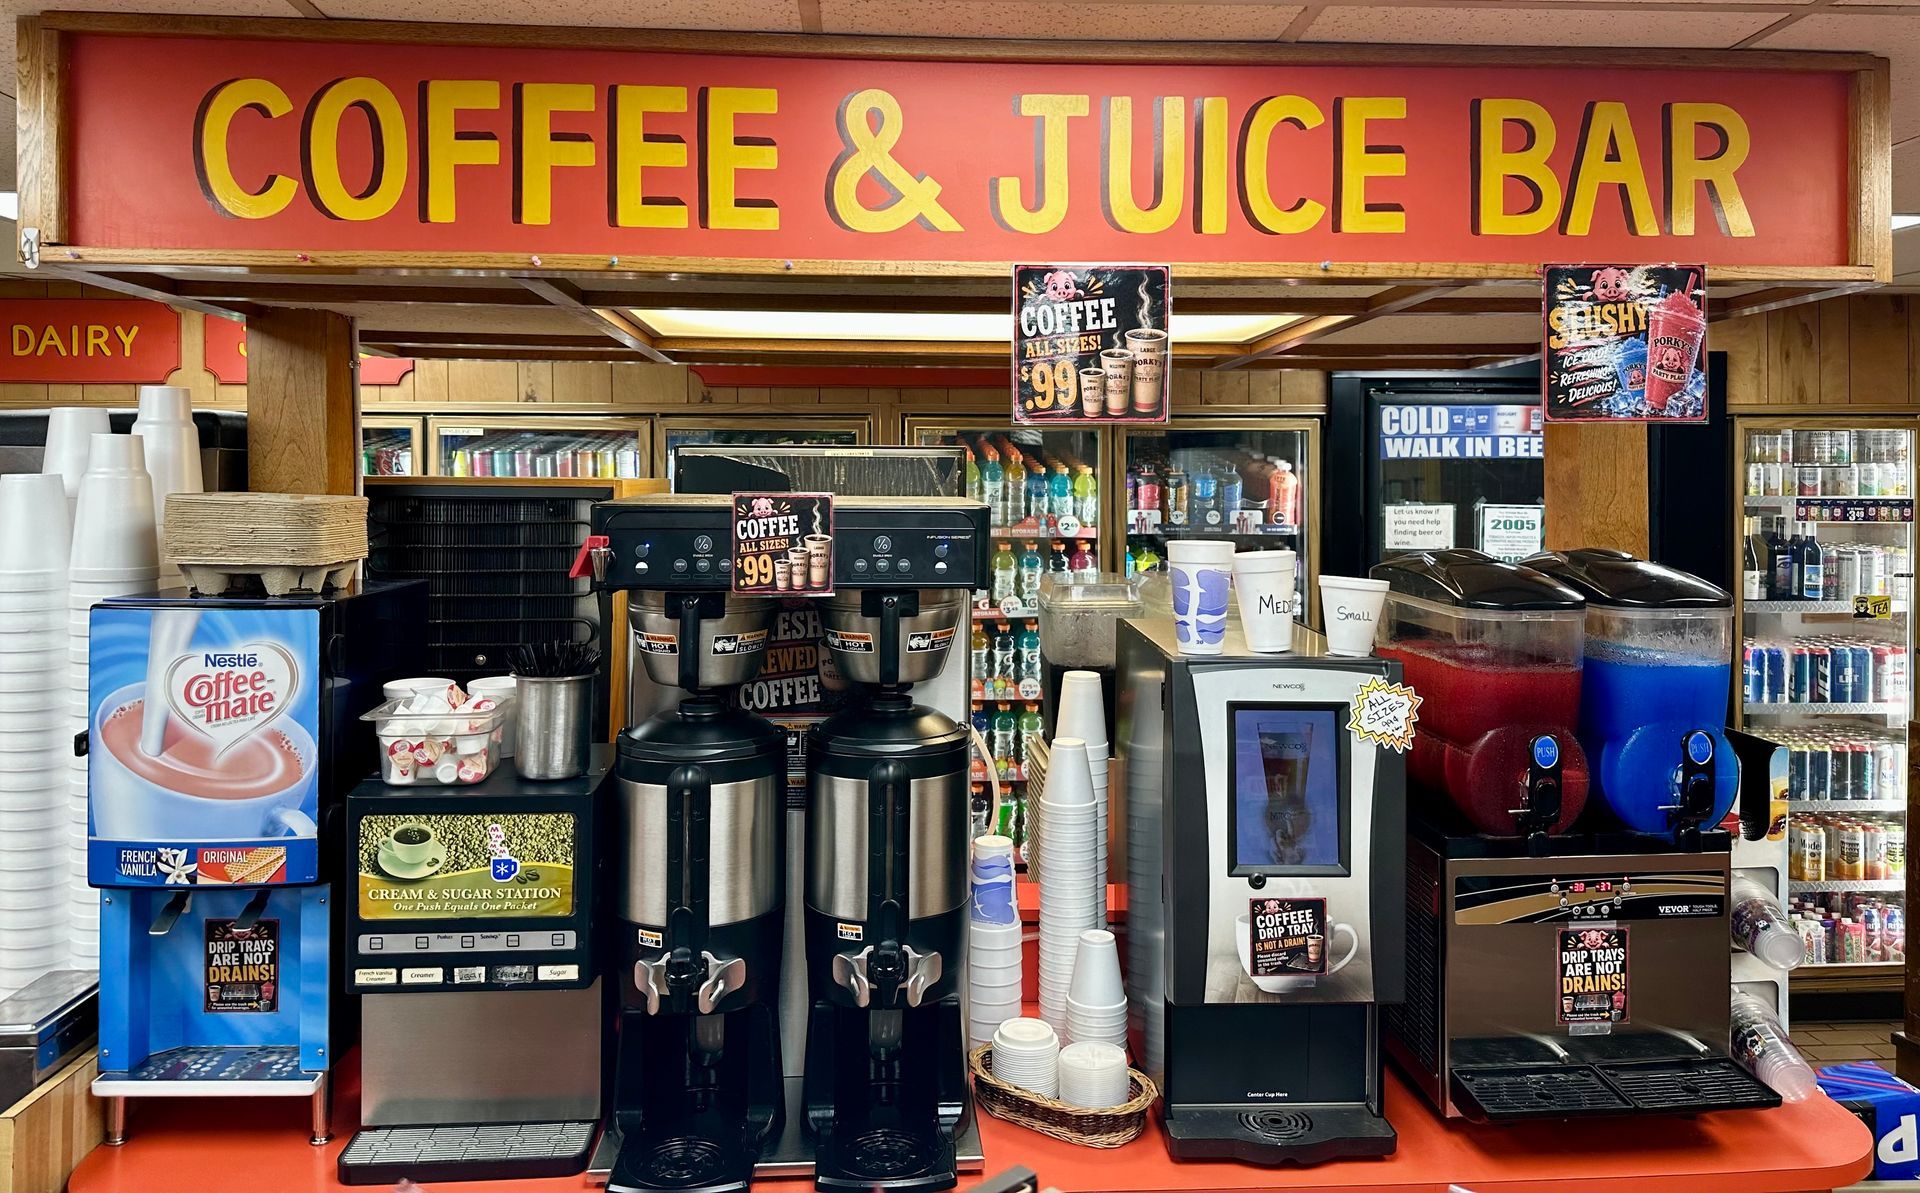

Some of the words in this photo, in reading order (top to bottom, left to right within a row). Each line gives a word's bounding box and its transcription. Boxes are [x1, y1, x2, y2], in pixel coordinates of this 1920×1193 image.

[197, 76, 781, 231] COFFEE
[828, 88, 963, 233] &
[990, 94, 1407, 236] JUICE
[1471, 97, 1756, 238] BAR
[1020, 297, 1117, 337] COFFEE
[1549, 302, 1649, 349] SLUSHY
[12, 324, 139, 357] DAIRY
[1026, 341, 1053, 358] ALL
[1057, 335, 1102, 354] SIZES!
[1653, 336, 1694, 356] PORKY'S
[1652, 368, 1668, 379] PARTY
[1669, 371, 1687, 381] PLACE
[1568, 379, 1618, 402] DELICIOUS!
[1382, 406, 1449, 435] COLD
[1385, 437, 1460, 458] WALK
[1465, 437, 1492, 457] IN
[1499, 437, 1544, 457] BEE
[736, 515, 799, 540] COFFEE
[1490, 519, 1536, 530] 2005
[740, 542, 758, 553] ALL
[760, 538, 790, 551] SIZES!
[736, 553, 774, 587] $.99
[1337, 606, 1373, 621] Small
[1872, 603, 1889, 614] TEA
[770, 610, 824, 640] ESH
[761, 645, 817, 674] EWED
[183, 670, 275, 707] Coffee-
[739, 675, 821, 711] COFFEE
[205, 692, 274, 724] mate
[1368, 695, 1391, 711] ALL
[1367, 700, 1405, 725] SIZES
[1537, 746, 1556, 758] PUSH
[1690, 742, 1710, 753] PUSH
[121, 850, 156, 863] FRENCH
[203, 851, 247, 863] ORIGINAL
[120, 863, 157, 876] VANILLA
[368, 889, 424, 900] CREAM
[426, 889, 438, 900] &
[442, 888, 493, 900] SUGAR
[494, 887, 562, 899] STATION
[393, 902, 413, 911] One
[415, 902, 441, 911] Push
[443, 902, 478, 913] Equals
[481, 902, 501, 911] One
[503, 901, 537, 911] Packet
[1658, 905, 1689, 913] VEVOR
[1256, 909, 1314, 929] COFFEEE
[1258, 926, 1285, 940] DRIP
[1286, 922, 1314, 936] TRAY
[209, 941, 235, 954] DRIP
[238, 939, 274, 952] TRAYS
[1255, 943, 1263, 952] IS
[1264, 941, 1277, 951] NOT
[1278, 940, 1283, 949] A
[1284, 937, 1306, 948] DRAIN!
[212, 953, 240, 966] ARE
[243, 951, 271, 965] NOT
[1562, 950, 1588, 964] DRIP
[1590, 948, 1625, 962] TRAYS
[209, 964, 275, 983] DRAINS!
[1565, 963, 1592, 977] ARE
[1595, 961, 1622, 975] NOT
[1562, 973, 1626, 994] DRAINS!
